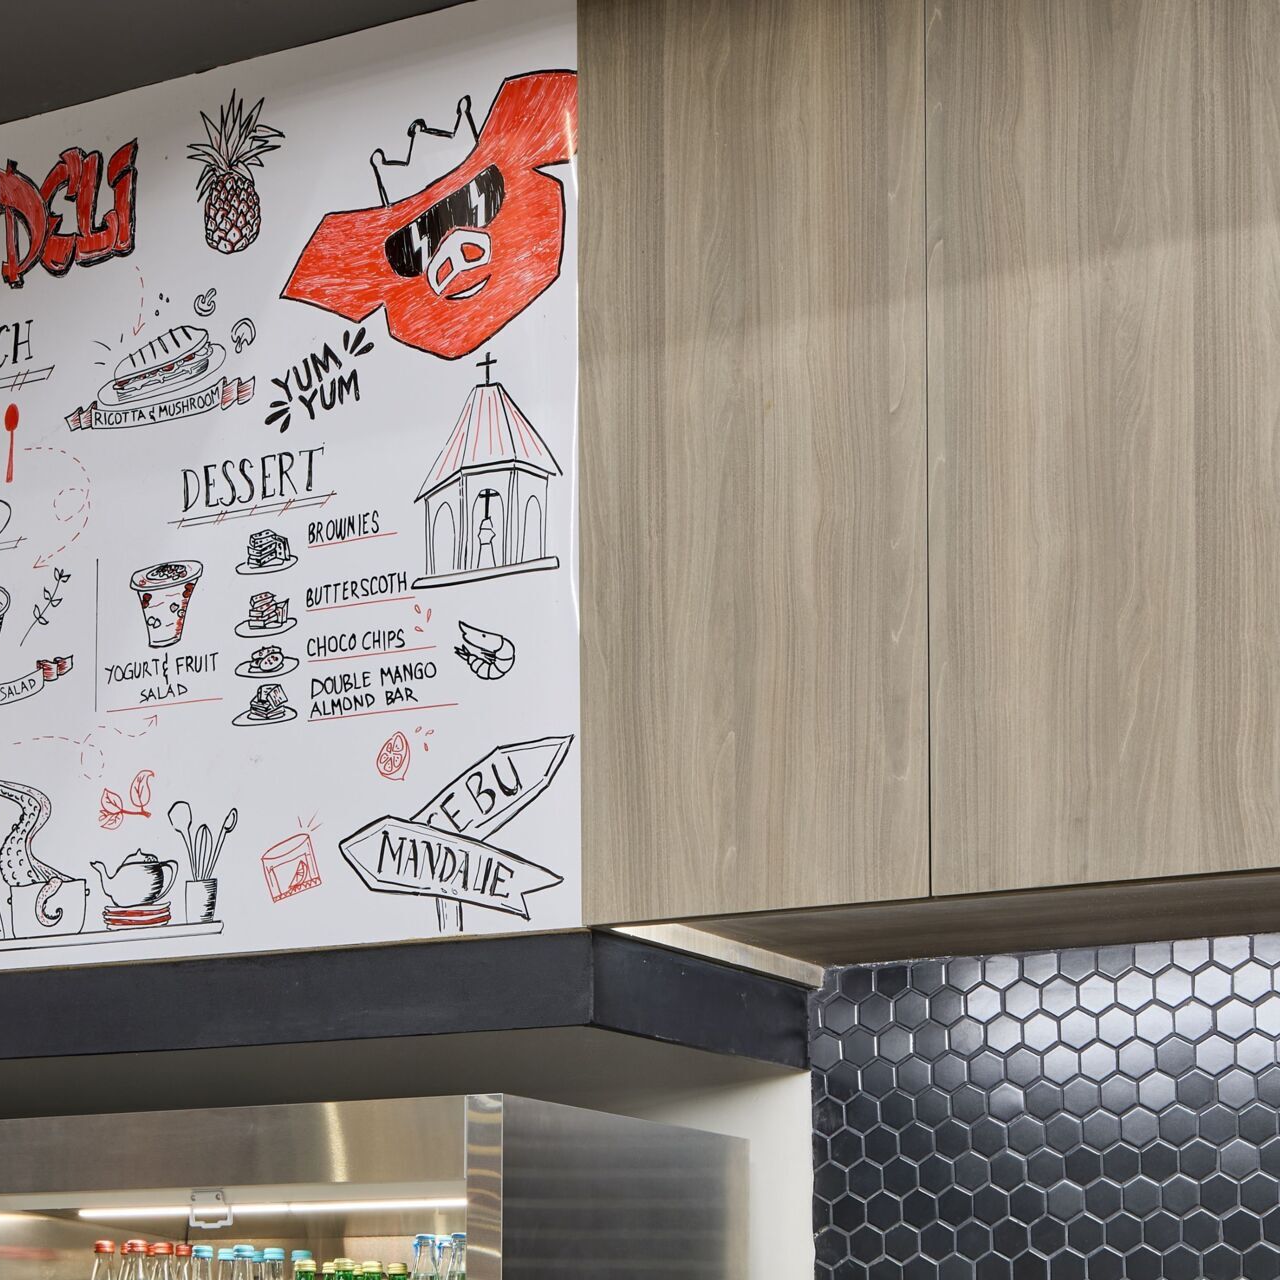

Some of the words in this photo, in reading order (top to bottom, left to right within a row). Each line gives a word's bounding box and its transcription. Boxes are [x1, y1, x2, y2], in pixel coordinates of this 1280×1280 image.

[271, 342, 342, 402] YUM
[94, 409, 146, 426] RICOTTA
[158, 388, 220, 419] MUSHROOM
[298, 368, 360, 420] YUM
[181, 446, 325, 513] DESSERT
[307, 510, 380, 544] BROWNIES
[306, 571, 408, 608] BUTTERSCOTH
[306, 632, 357, 658] CHOCO
[361, 628, 406, 652] CHIPS
[104, 657, 160, 685] YOGURT
[175, 652, 219, 676] FRUIT
[310, 671, 372, 700] DOUBLE
[380, 661, 437, 687] MANGO
[0, 678, 37, 702] SALAD
[139, 683, 188, 704] SALAD
[309, 693, 376, 719] ALMOND
[385, 686, 419, 706] BAR
